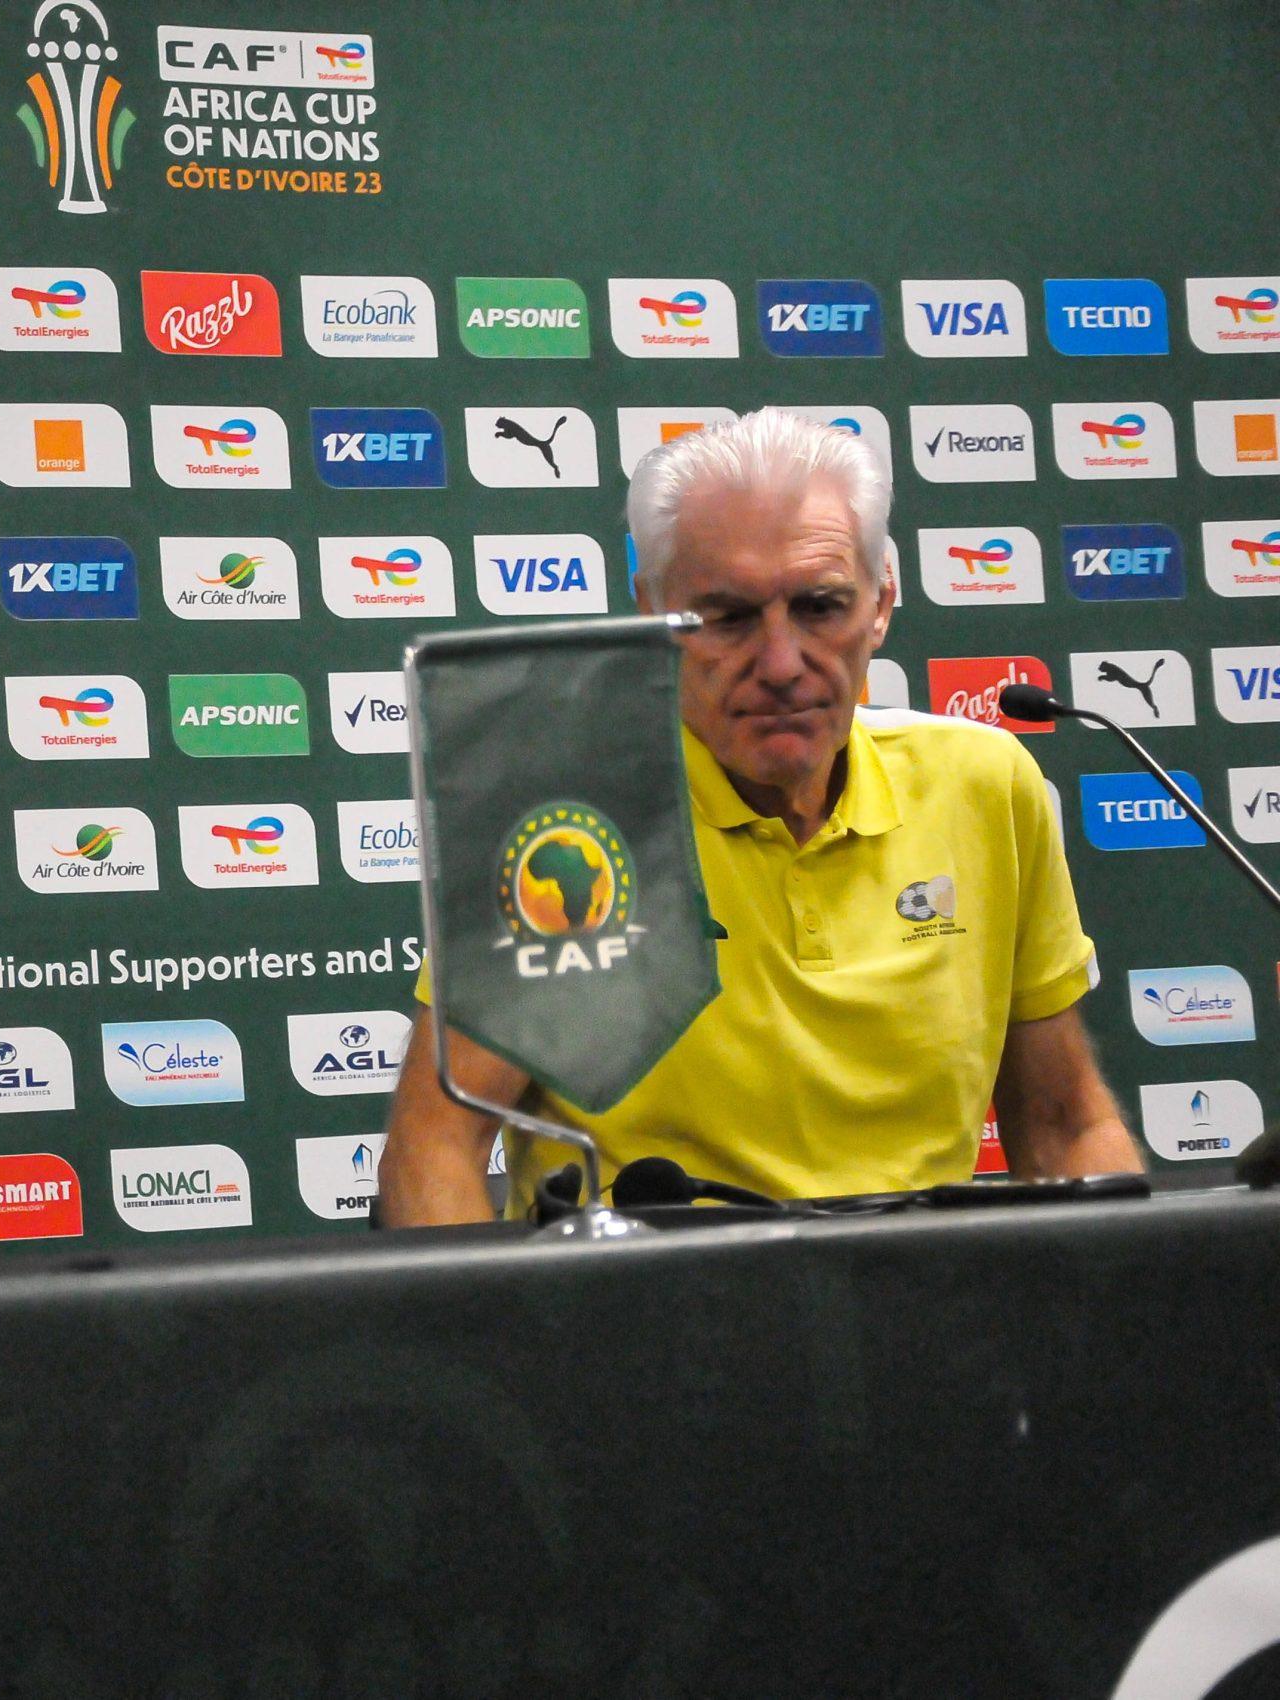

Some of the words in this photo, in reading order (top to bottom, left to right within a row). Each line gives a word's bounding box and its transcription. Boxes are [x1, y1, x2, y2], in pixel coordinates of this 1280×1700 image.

[165, 40, 275, 72] CAF
[163, 87, 296, 123] AFRICA
[305, 92, 377, 125] CUP
[163, 124, 213, 156] OF
[223, 127, 380, 162] NATIONS
[166, 162, 230, 191] CÔTE
[237, 168, 348, 193] D'IVOIRE
[354, 172, 382, 195] 23
[160, 280, 253, 349] Razzl
[324, 290, 416, 324] Ecobank
[466, 308, 581, 328] APSONIC
[767, 303, 870, 332] 1XBET
[916, 302, 1009, 336] VISA
[1062, 305, 1151, 329] TECNO
[13, 326, 89, 340] TotalEnergies
[641, 334, 710, 347] TotalEnergies
[322, 432, 432, 462] 1XBET
[948, 431, 1024, 452] Rexona
[38, 457, 80, 470] orange
[185, 464, 260, 477] TotalEnergies
[1071, 547, 1172, 577] 1XBET
[8, 562, 124, 593] 1XBET
[489, 557, 588, 592] VISA
[177, 590, 198, 605] Air
[201, 589, 233, 605] Côte
[236, 590, 287, 605] d'Ivoire
[950, 582, 1017, 593] TotalEnergies
[353, 594, 425, 606] TotalEnergies
[180, 704, 300, 726] APSONIC
[370, 699, 407, 722] Rex
[41, 734, 117, 747] TotalEnergies
[1098, 799, 1187, 823] TECNO
[32, 864, 54, 879] Air
[56, 862, 89, 878] Côte
[92, 861, 144, 877] d'Ivoire
[214, 862, 287, 875] TotalEnergies
[109, 948, 316, 991] Supporters
[325, 938, 393, 974] and
[518, 937, 628, 978] CAF
[1166, 987, 1232, 1015] Céleste
[143, 1043, 219, 1072] Céleste
[313, 1050, 400, 1073] AGL
[1178, 1138, 1230, 1151] PORTEO
[122, 1170, 211, 1198] LONACI
